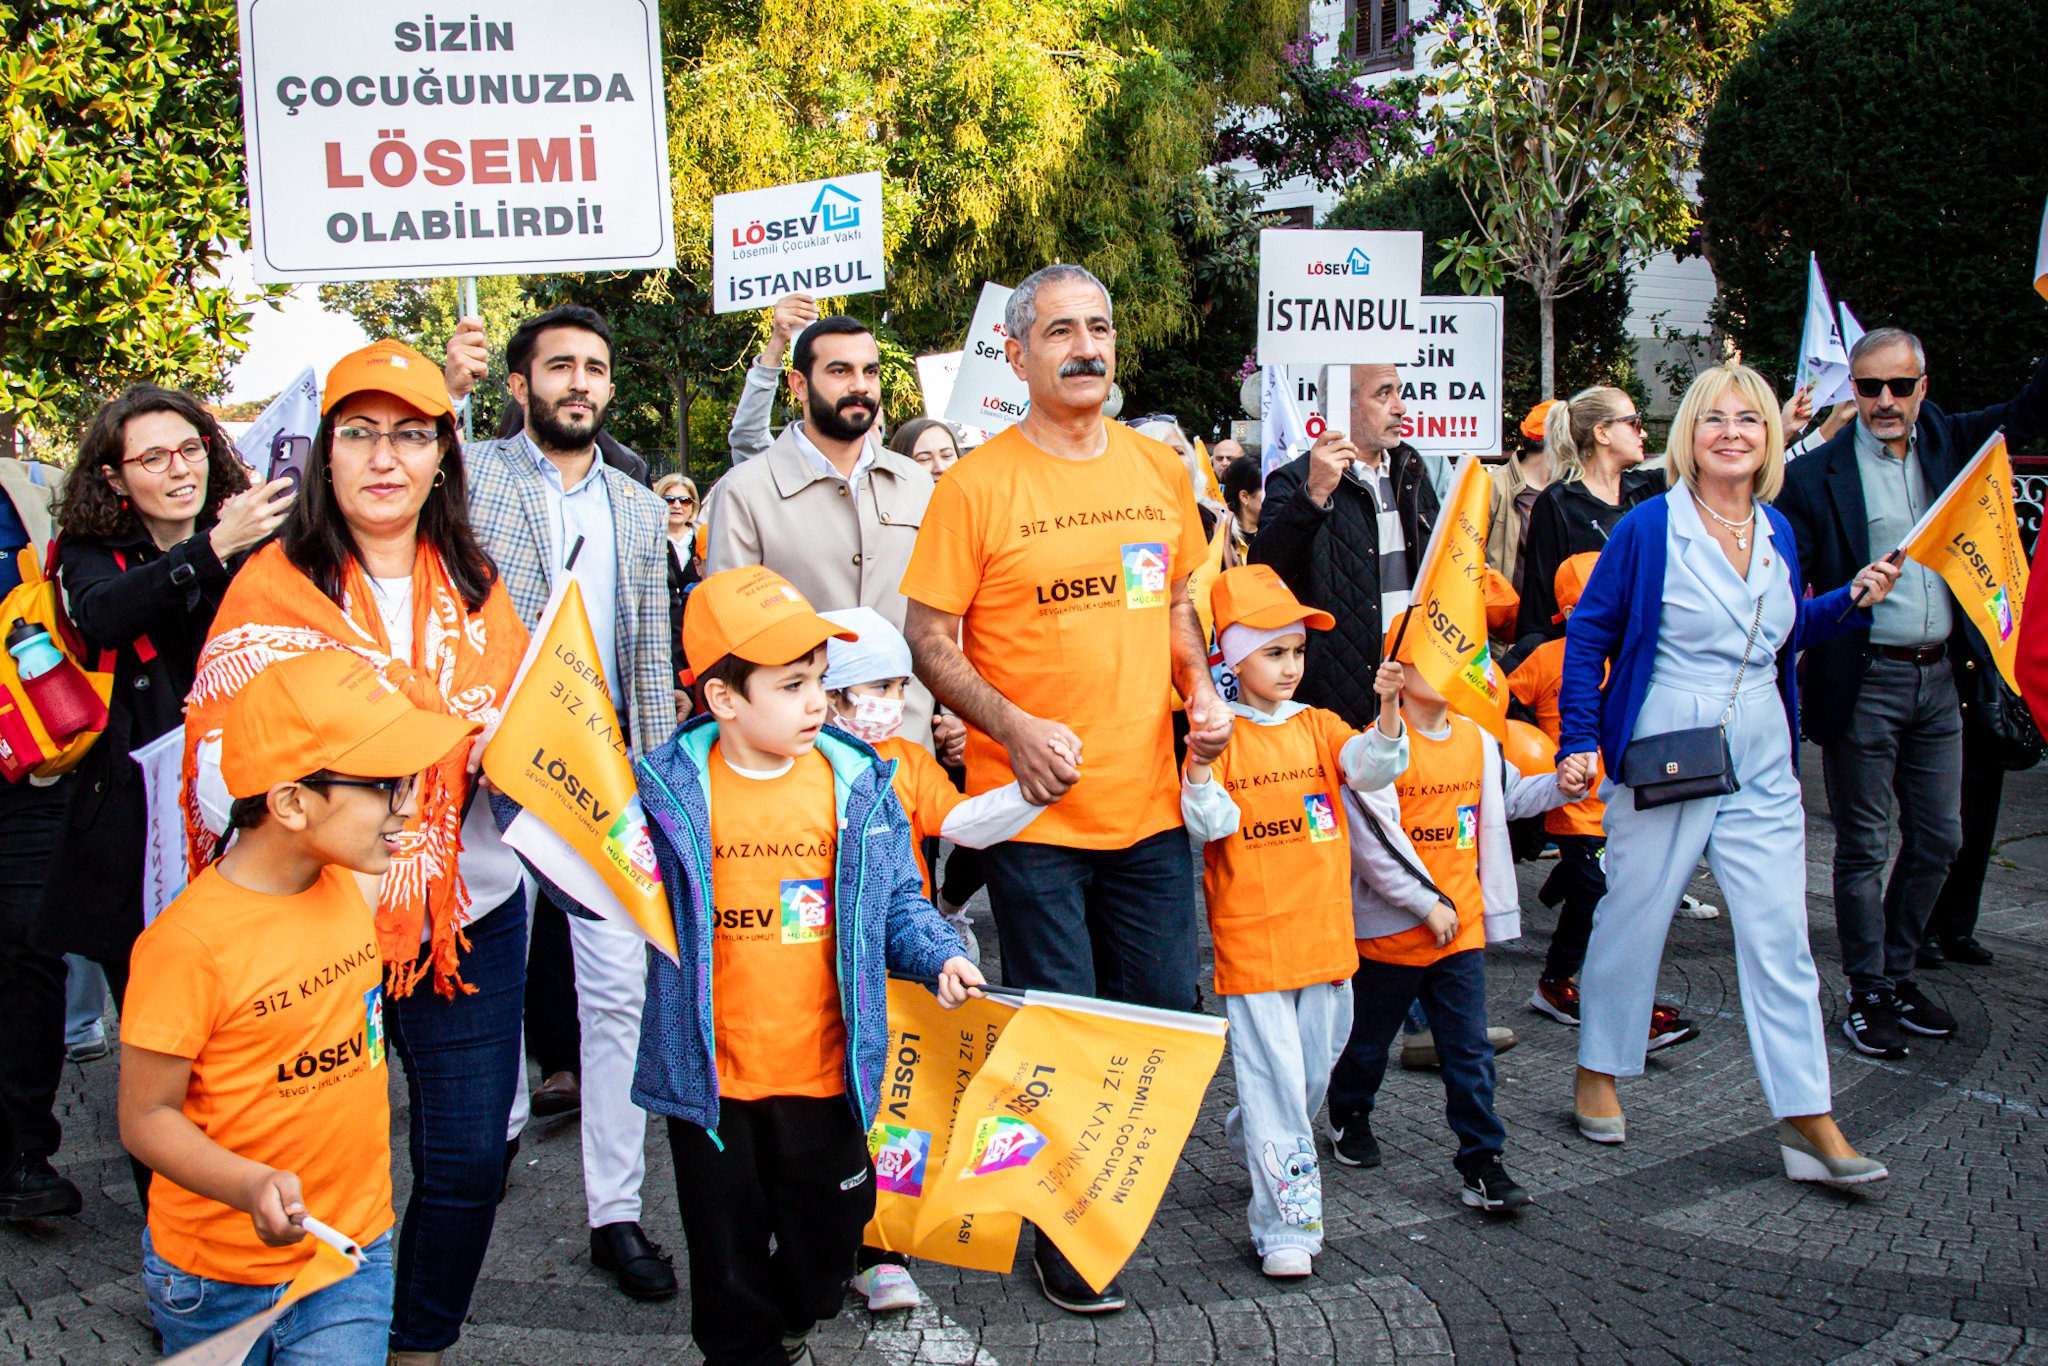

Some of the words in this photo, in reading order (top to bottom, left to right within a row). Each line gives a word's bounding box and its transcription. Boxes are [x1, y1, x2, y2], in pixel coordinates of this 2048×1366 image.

[395, 14, 514, 52] SİZİN
[277, 67, 635, 116] ÇOCUĞUNUZDA
[324, 124, 598, 188] LÖSEMİ
[326, 197, 603, 243] OLABİLİRDİ!
[732, 215, 817, 247] LÖSEV
[733, 245, 778, 260] Lösemili
[782, 236, 831, 255] Çocuklar
[834, 230, 862, 244] Vakfı
[729, 260, 872, 302] İSTANBUL
[1307, 261, 1350, 276] LÖSEV
[1267, 291, 1414, 331] İSTANBUL
[975, 340, 1004, 361] Ser
[983, 396, 1026, 417] LÖSEV
[1449, 382, 1486, 401] DA
[1020, 521, 1048, 537] BİZ
[1054, 506, 1166, 529] KAZANACAĞIZ
[1952, 532, 1997, 588] LÖSEV
[1036, 574, 1117, 604] LÖSEV
[550, 680, 584, 715] BİZ
[531, 747, 610, 822] LÖSEV
[1227, 779, 1248, 792] BİZ
[525, 769, 549, 790] SEVGİ
[578, 814, 601, 838] UMUT
[1243, 817, 1302, 840] LÖSEV
[606, 845, 654, 892] MÜCADELE
[713, 906, 774, 928] ÖSEV
[751, 933, 775, 942] UMUT
[254, 991, 293, 1017] BİZ
[277, 1031, 362, 1082] LÖSEV
[959, 1030, 974, 1062] BİZ
[279, 1084, 309, 1098] SEVGİ
[889, 1032, 921, 1120] LÖSEV
[1005, 1065, 1056, 1117] LÖSEV
[1103, 1055, 1129, 1091] BİZ
[1128, 1048, 1166, 1121] LÖSEMİLİ
[1037, 1101, 1114, 1194] KAZANACAĞIZ
[1137, 1127, 1156, 1150] 2-8
[1087, 1123, 1134, 1200] ÇOCUKLAR
[1110, 1155, 1145, 1204] KASIM
